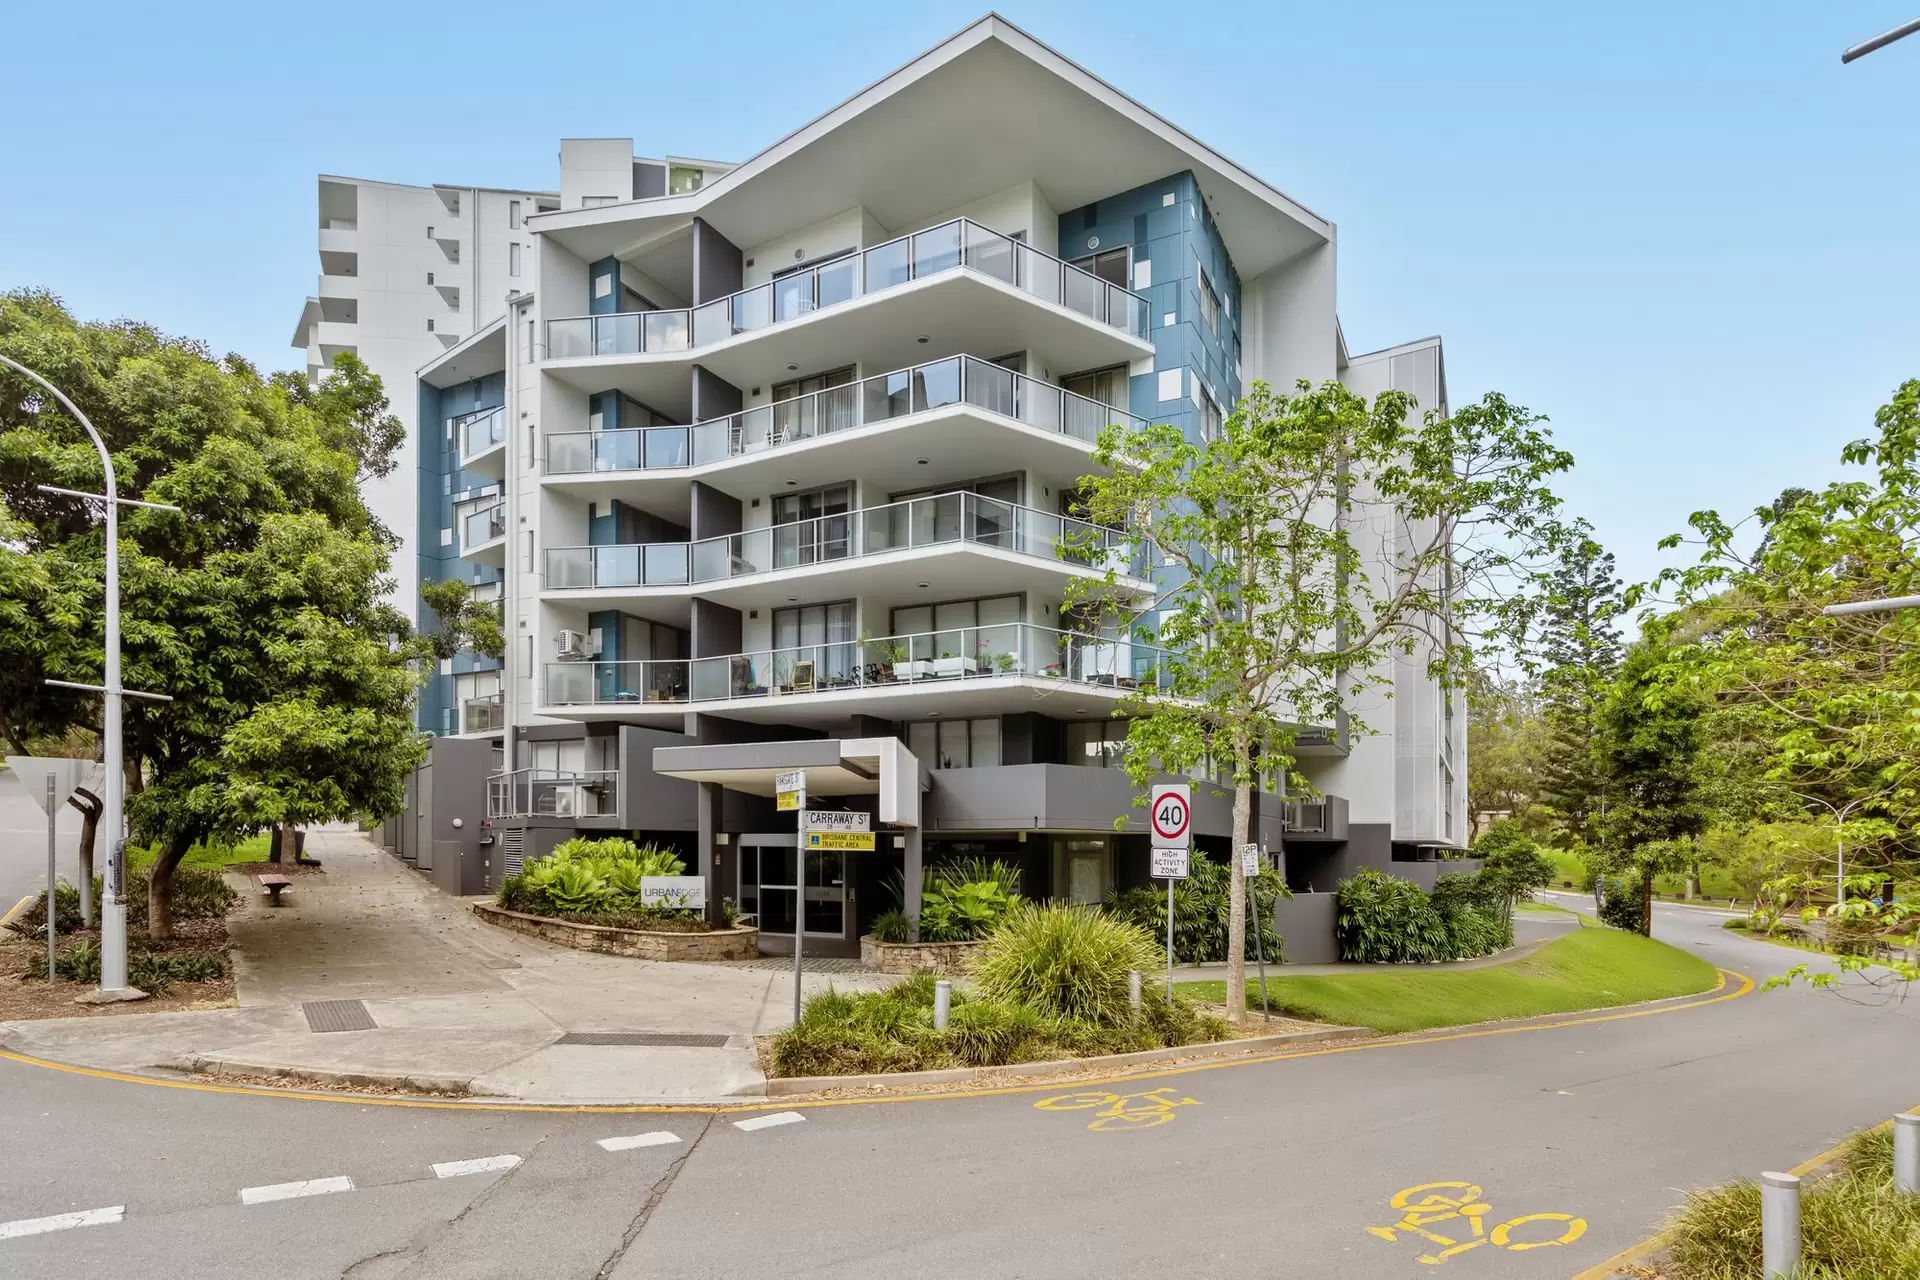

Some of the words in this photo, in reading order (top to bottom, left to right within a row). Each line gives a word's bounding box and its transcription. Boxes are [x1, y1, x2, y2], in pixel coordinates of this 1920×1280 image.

[810, 812, 854, 824] CARRAWAY
[858, 813, 867, 825] ST
[1158, 805, 1182, 826] 40
[821, 833, 848, 841] BRISBANE
[849, 834, 873, 842] CENTRAL
[1161, 850, 1178, 858] HIGH
[1160, 867, 1179, 875] ZONE
